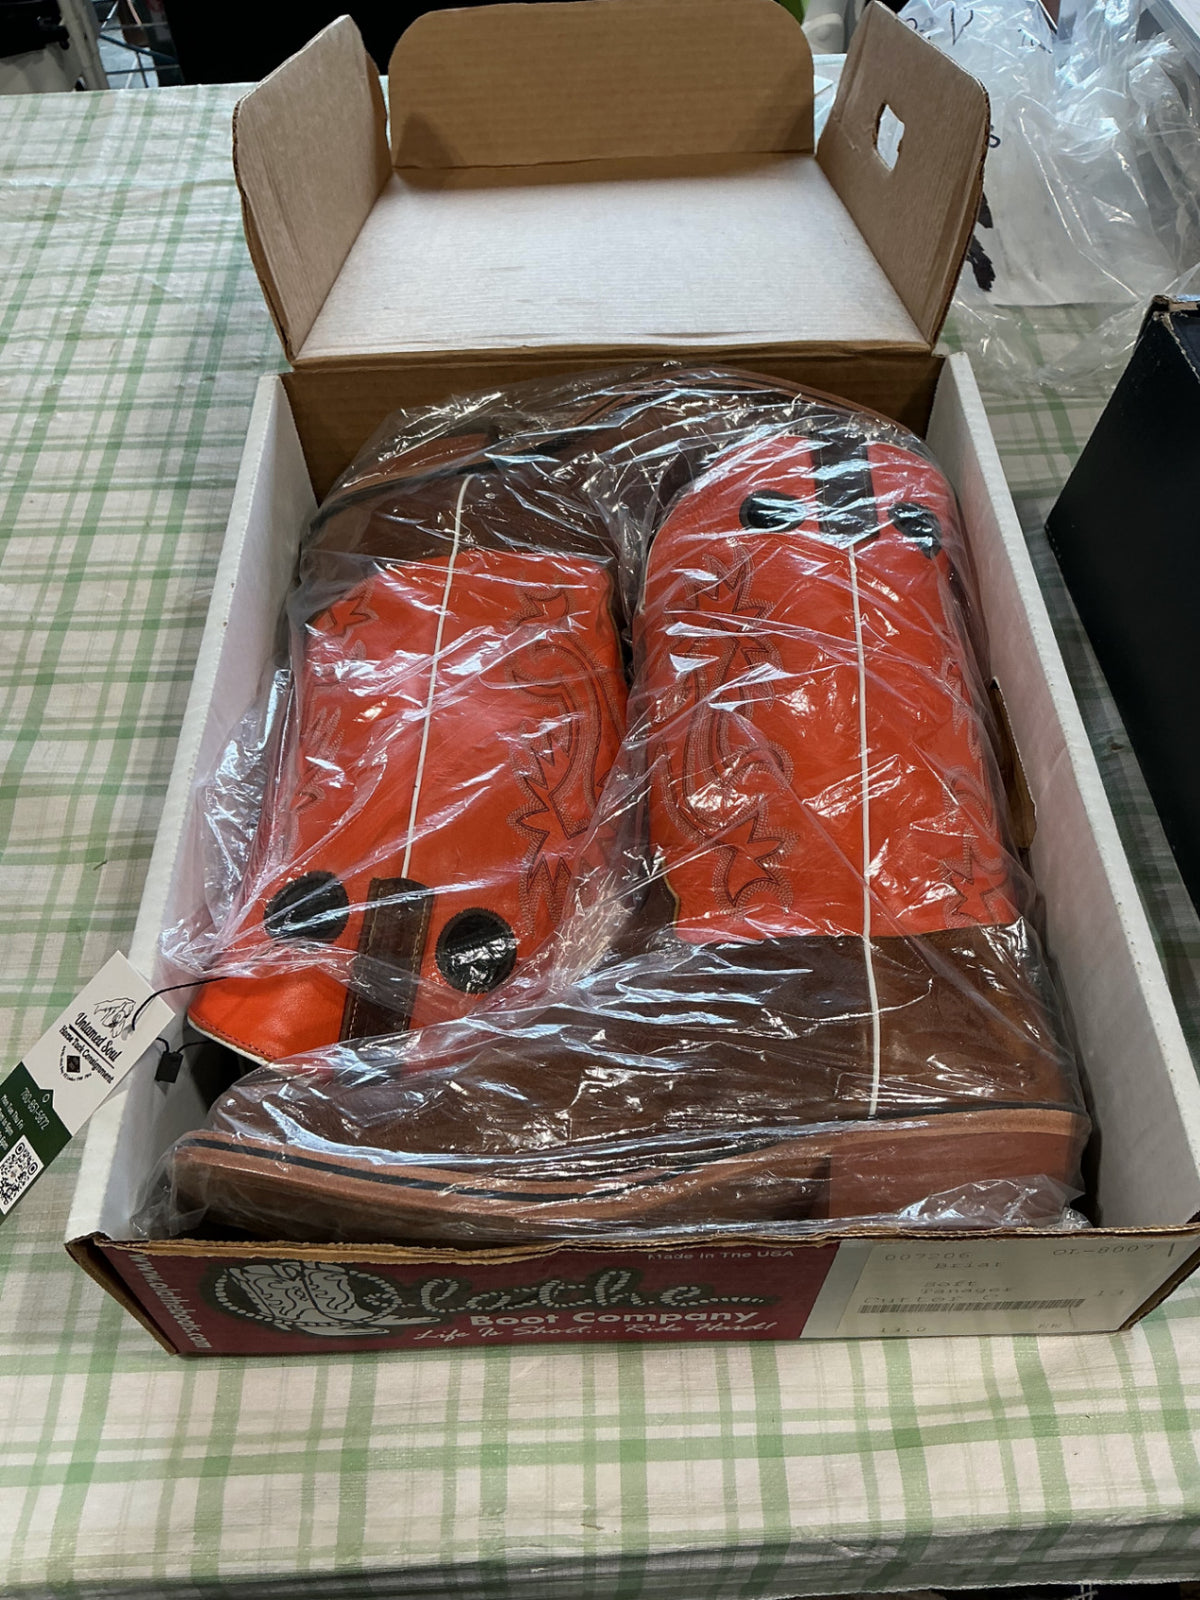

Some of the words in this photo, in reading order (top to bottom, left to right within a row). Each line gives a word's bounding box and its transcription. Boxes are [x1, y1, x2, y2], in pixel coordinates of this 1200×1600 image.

[75, 1012, 107, 1048] Untamed
[101, 1039, 123, 1062] Soul
[59, 1025, 74, 1043] Horse
[72, 1037, 86, 1053] Tack
[82, 1048, 116, 1084] Consignment
[11, 1110, 20, 1124] Thu
[16, 1119, 24, 1130] Fri
[648, 1252, 694, 1261] Made
[721, 1251, 752, 1259] The
[471, 1314, 560, 1326] Boot
[572, 1311, 758, 1325] Company
[412, 1329, 471, 1342] Life
[479, 1327, 504, 1337] Is
[625, 1324, 686, 1334] Ride
[695, 1321, 778, 1332] Hard!
